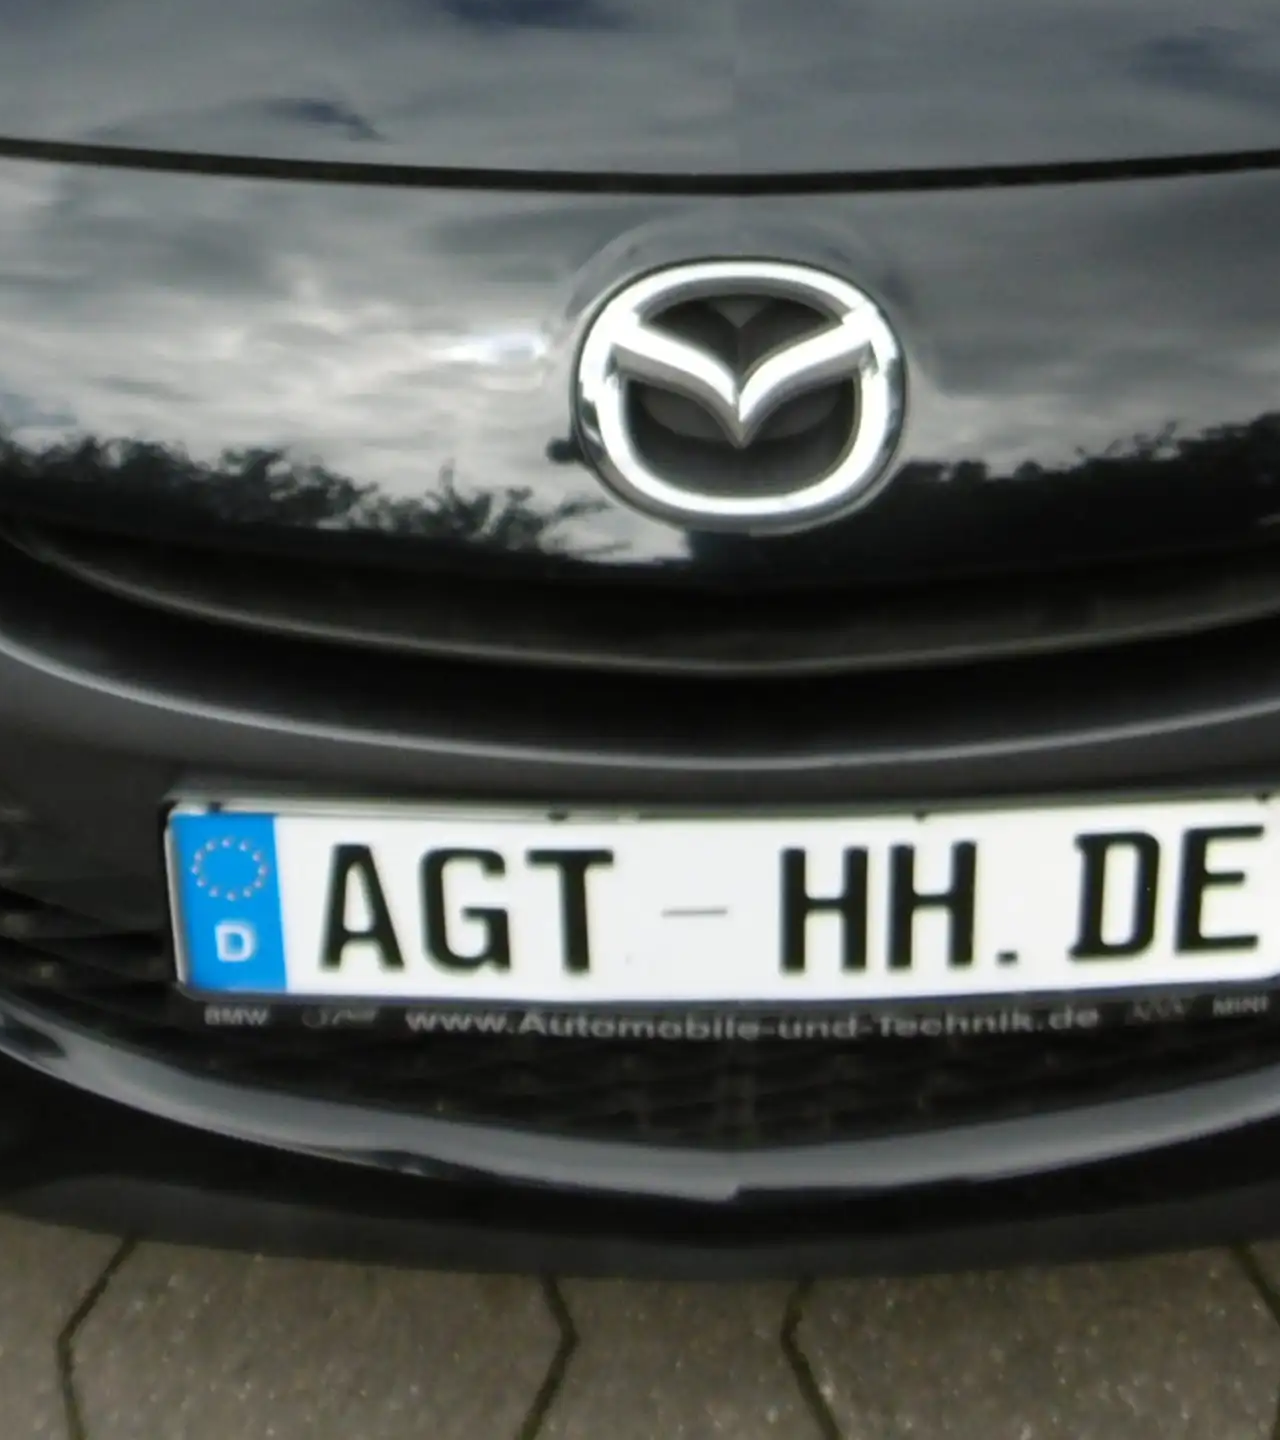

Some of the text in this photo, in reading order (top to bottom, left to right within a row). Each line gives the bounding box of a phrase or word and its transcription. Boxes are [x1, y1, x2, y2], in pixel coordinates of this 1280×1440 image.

[320, 843, 614, 975] AGT
[778, 841, 1018, 974] HH.
[1067, 825, 1264, 960] DE
[214, 922, 254, 962] D
[204, 1005, 269, 1027] BMW
[405, 1006, 1100, 1041] www.Automobile-und-Technik.de
